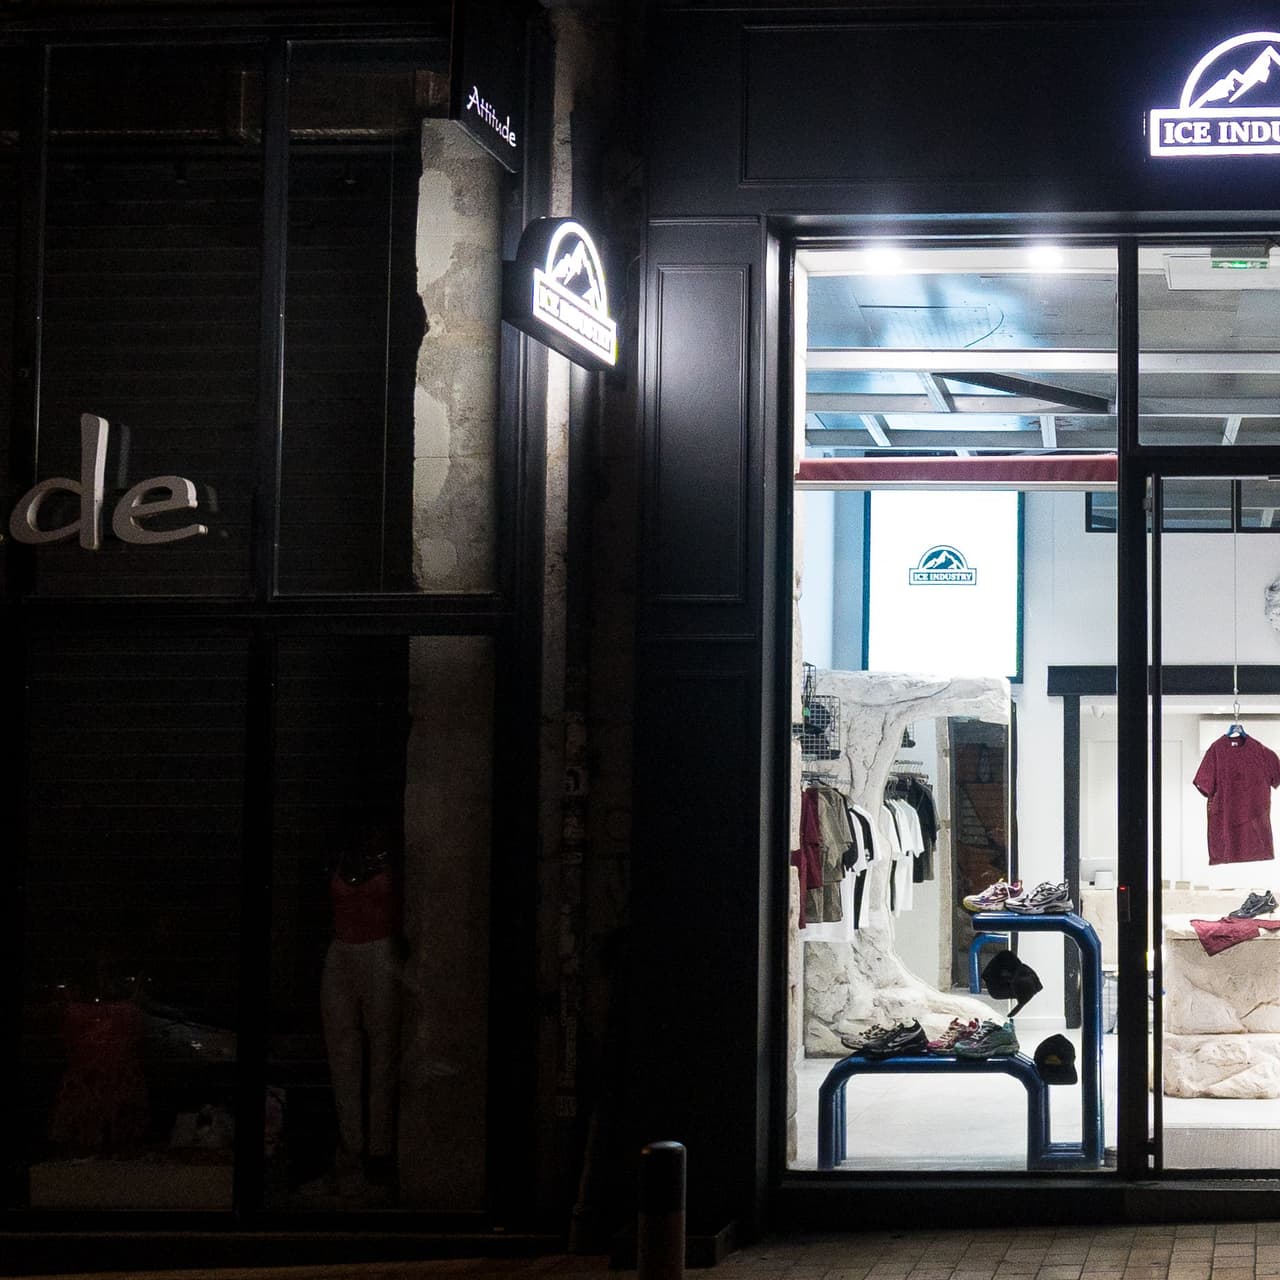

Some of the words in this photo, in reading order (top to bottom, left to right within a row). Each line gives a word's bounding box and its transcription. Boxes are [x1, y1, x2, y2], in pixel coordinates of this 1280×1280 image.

[466, 85, 517, 147] Attitude
[1163, 121, 1212, 144] ICE
[0, 412, 209, 552] de
[930, 573, 972, 581] INDUSTRY
